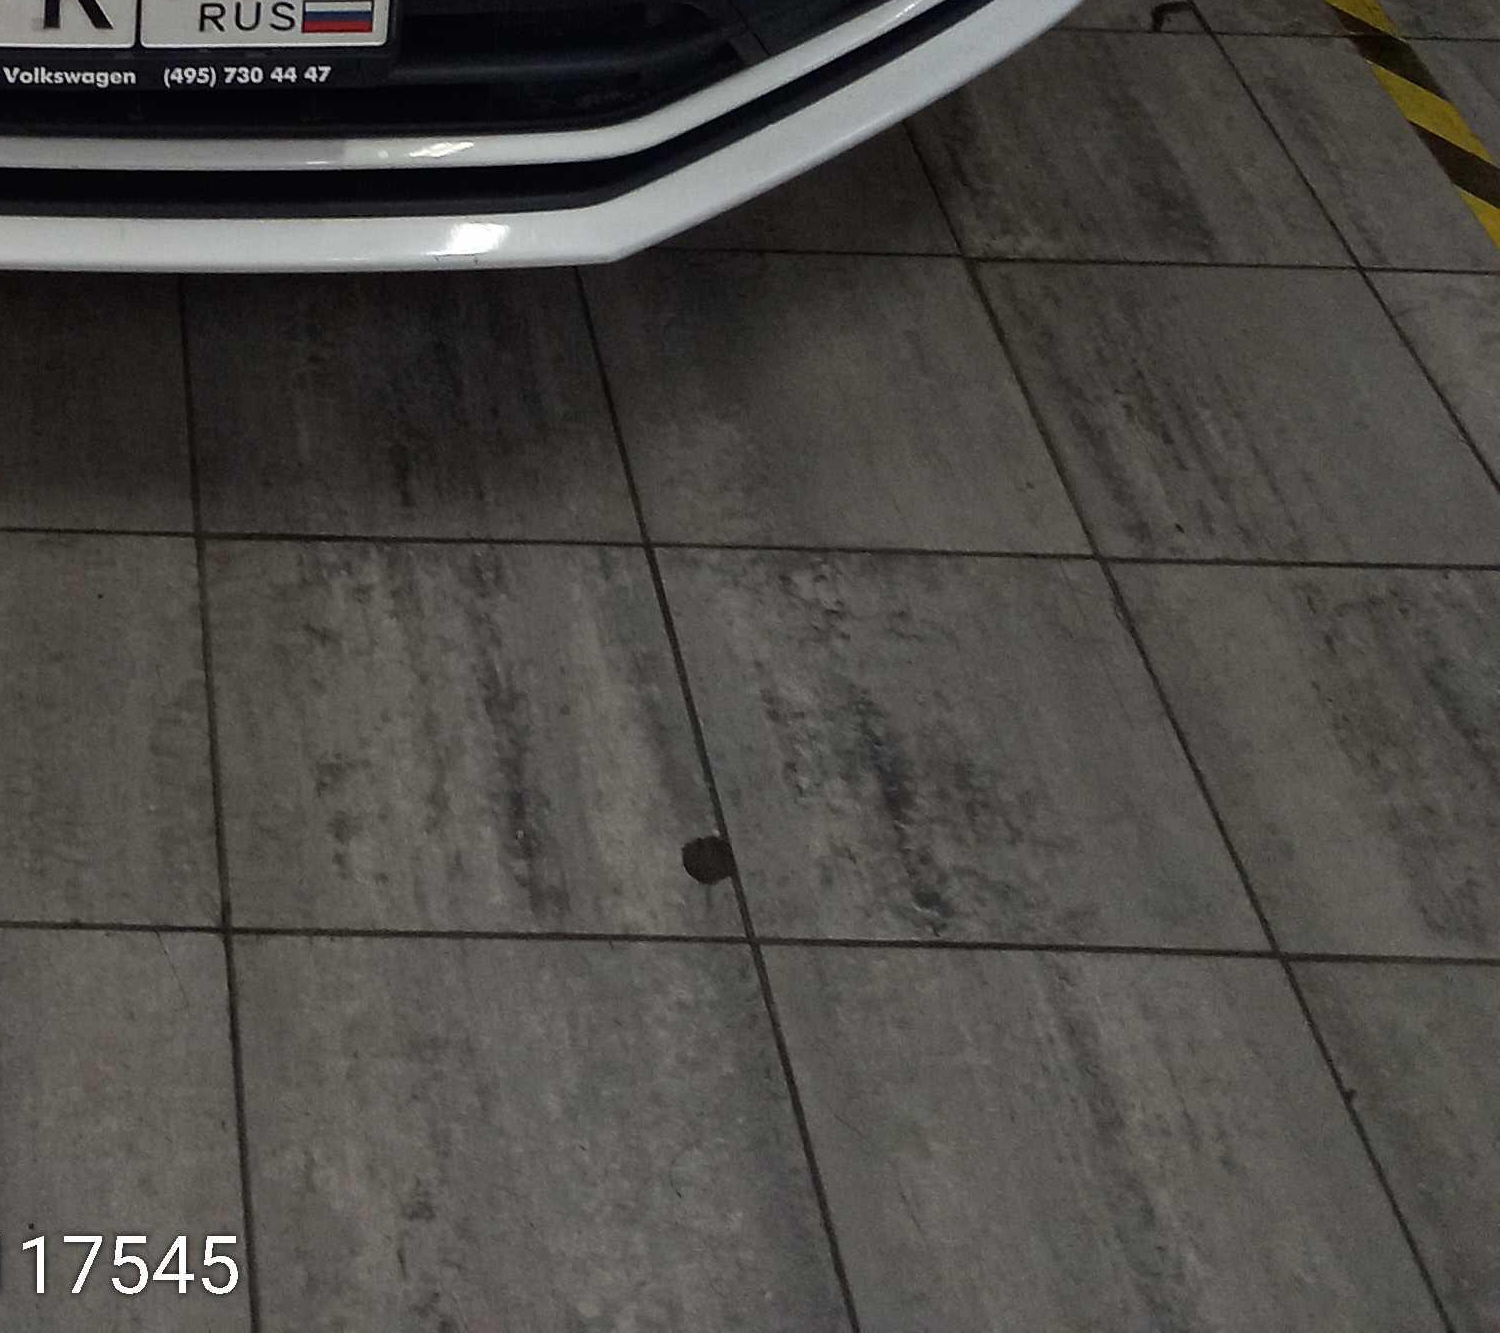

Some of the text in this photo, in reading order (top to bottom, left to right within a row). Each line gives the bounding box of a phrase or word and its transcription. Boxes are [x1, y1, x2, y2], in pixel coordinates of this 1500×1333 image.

[199, 1, 296, 33] RUS
[2, 66, 137, 88] Volkswagen
[163, 66, 217, 88] (495)
[223, 66, 264, 84] 730
[270, 66, 298, 83] 44
[304, 66, 332, 83] 47
